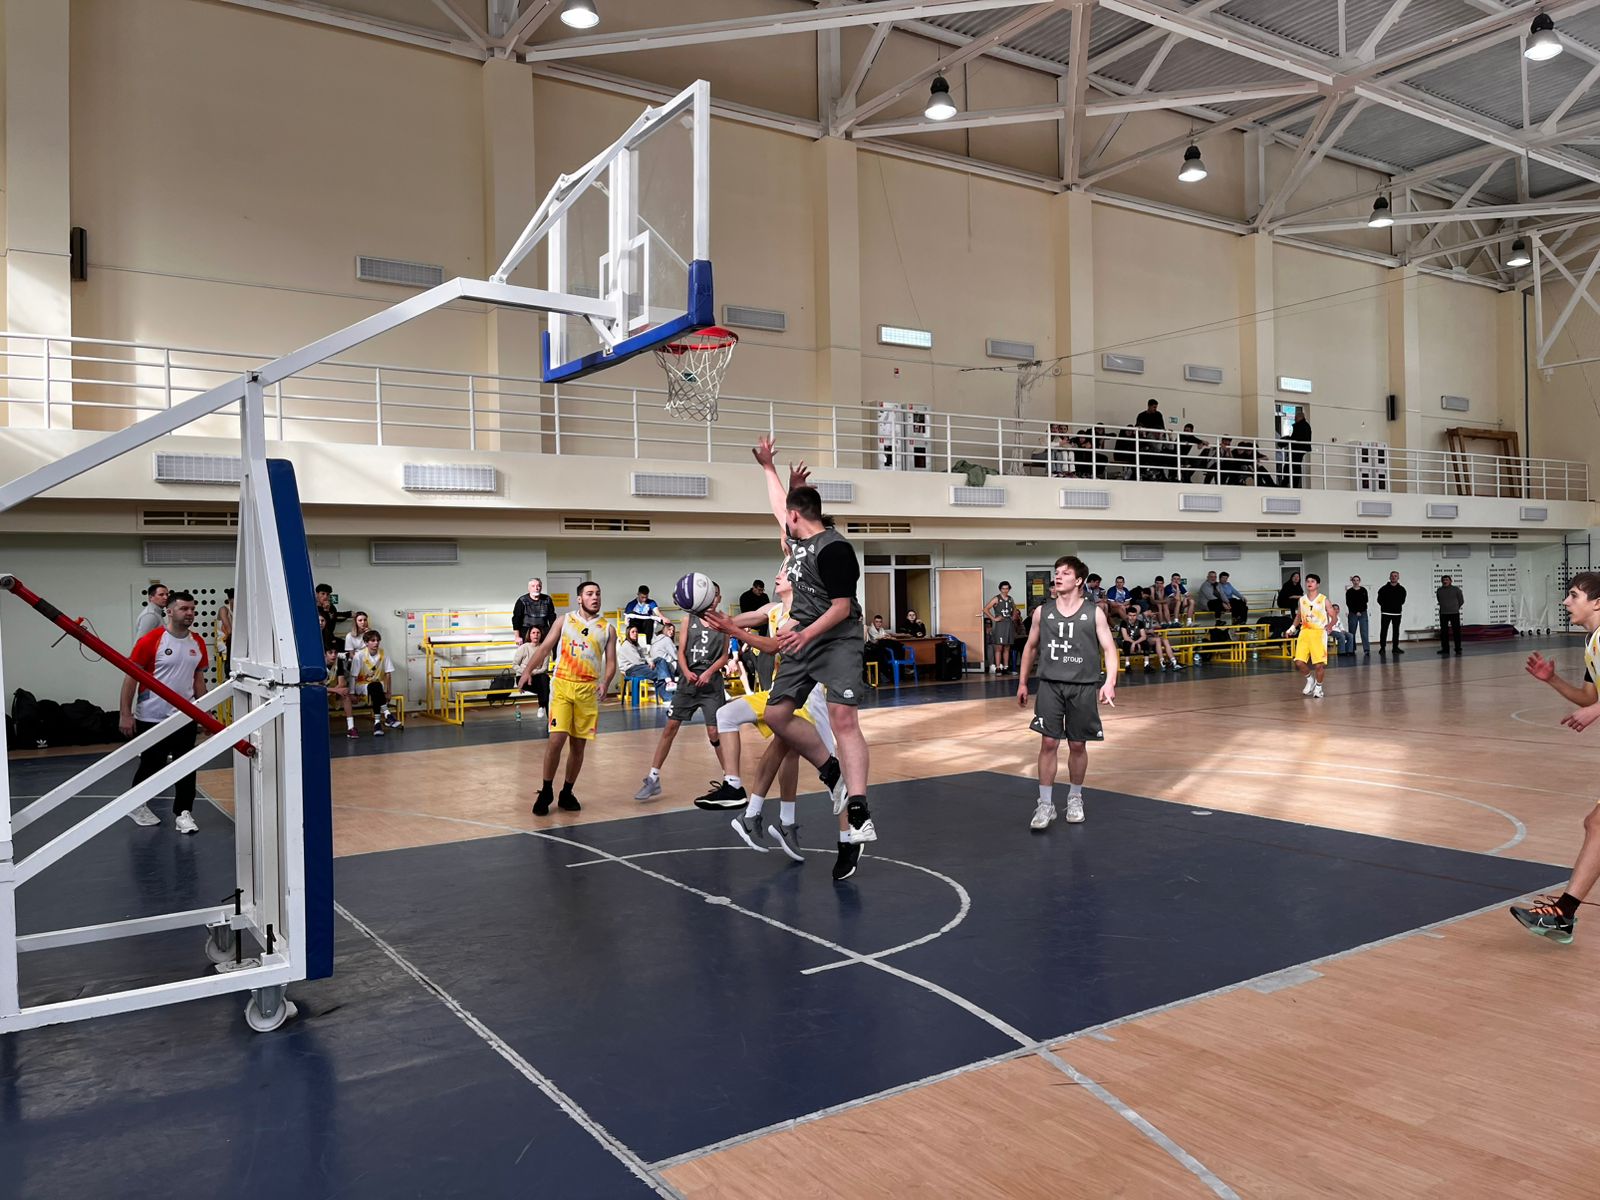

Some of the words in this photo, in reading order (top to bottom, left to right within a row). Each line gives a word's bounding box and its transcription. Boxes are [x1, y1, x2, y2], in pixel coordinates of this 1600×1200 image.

[581, 628, 589, 637] 4
[1058, 622, 1074, 638] 11
[701, 631, 709, 643] 5
[1063, 656, 1083, 664] group
[551, 718, 557, 727] 4
